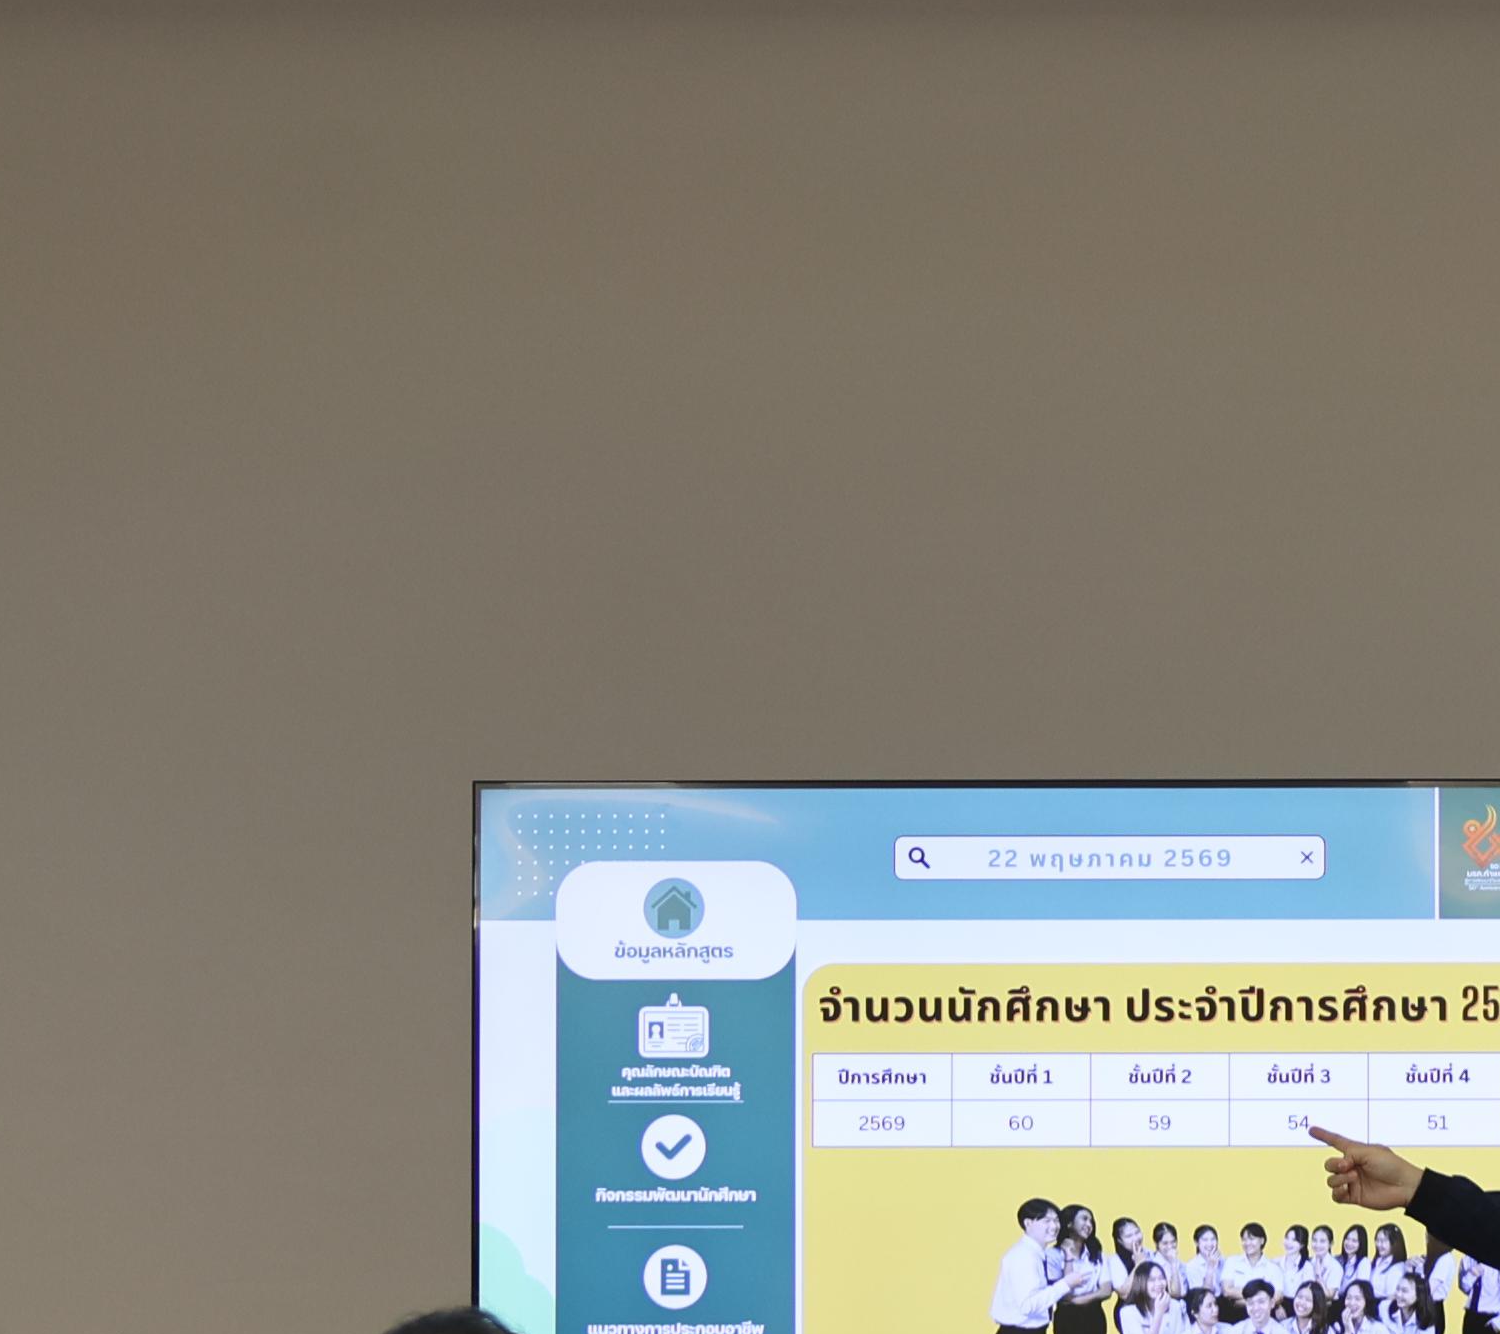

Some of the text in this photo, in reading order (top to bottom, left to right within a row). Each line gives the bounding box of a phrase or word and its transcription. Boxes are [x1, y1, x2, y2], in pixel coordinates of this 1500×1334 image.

[987, 848, 1231, 873] 22 พฤษภาคม 2569
[614, 940, 734, 964] ข้อมูลหลักสูตร
[819, 985, 1112, 1023] จำนวนนักศึกษา
[1126, 985, 1448, 1023] ประจำปีการศึกษา
[621, 1064, 731, 1081] คุณลักษณะบัณฑิต
[838, 1068, 928, 1085] ปีการศึกษา
[990, 1064, 1053, 1085] ชั้นปีที่ 1
[1129, 1064, 1192, 1085] ชั้นปีที่ 2
[1267, 1064, 1331, 1085] ชั้นปีที่ 3
[1405, 1064, 1470, 1085] ชั้นปีที่ 4
[611, 1082, 741, 1101] และผลลัพธ์การเรียนรู้
[858, 1114, 906, 1131] 2569
[1008, 1114, 1034, 1131] 60
[1148, 1114, 1172, 1131] 59
[1287, 1114, 1310, 1131] 54
[1427, 1114, 1449, 1131] 51
[595, 1186, 757, 1203] กิจกรรมพัฒนานักศึกษา
